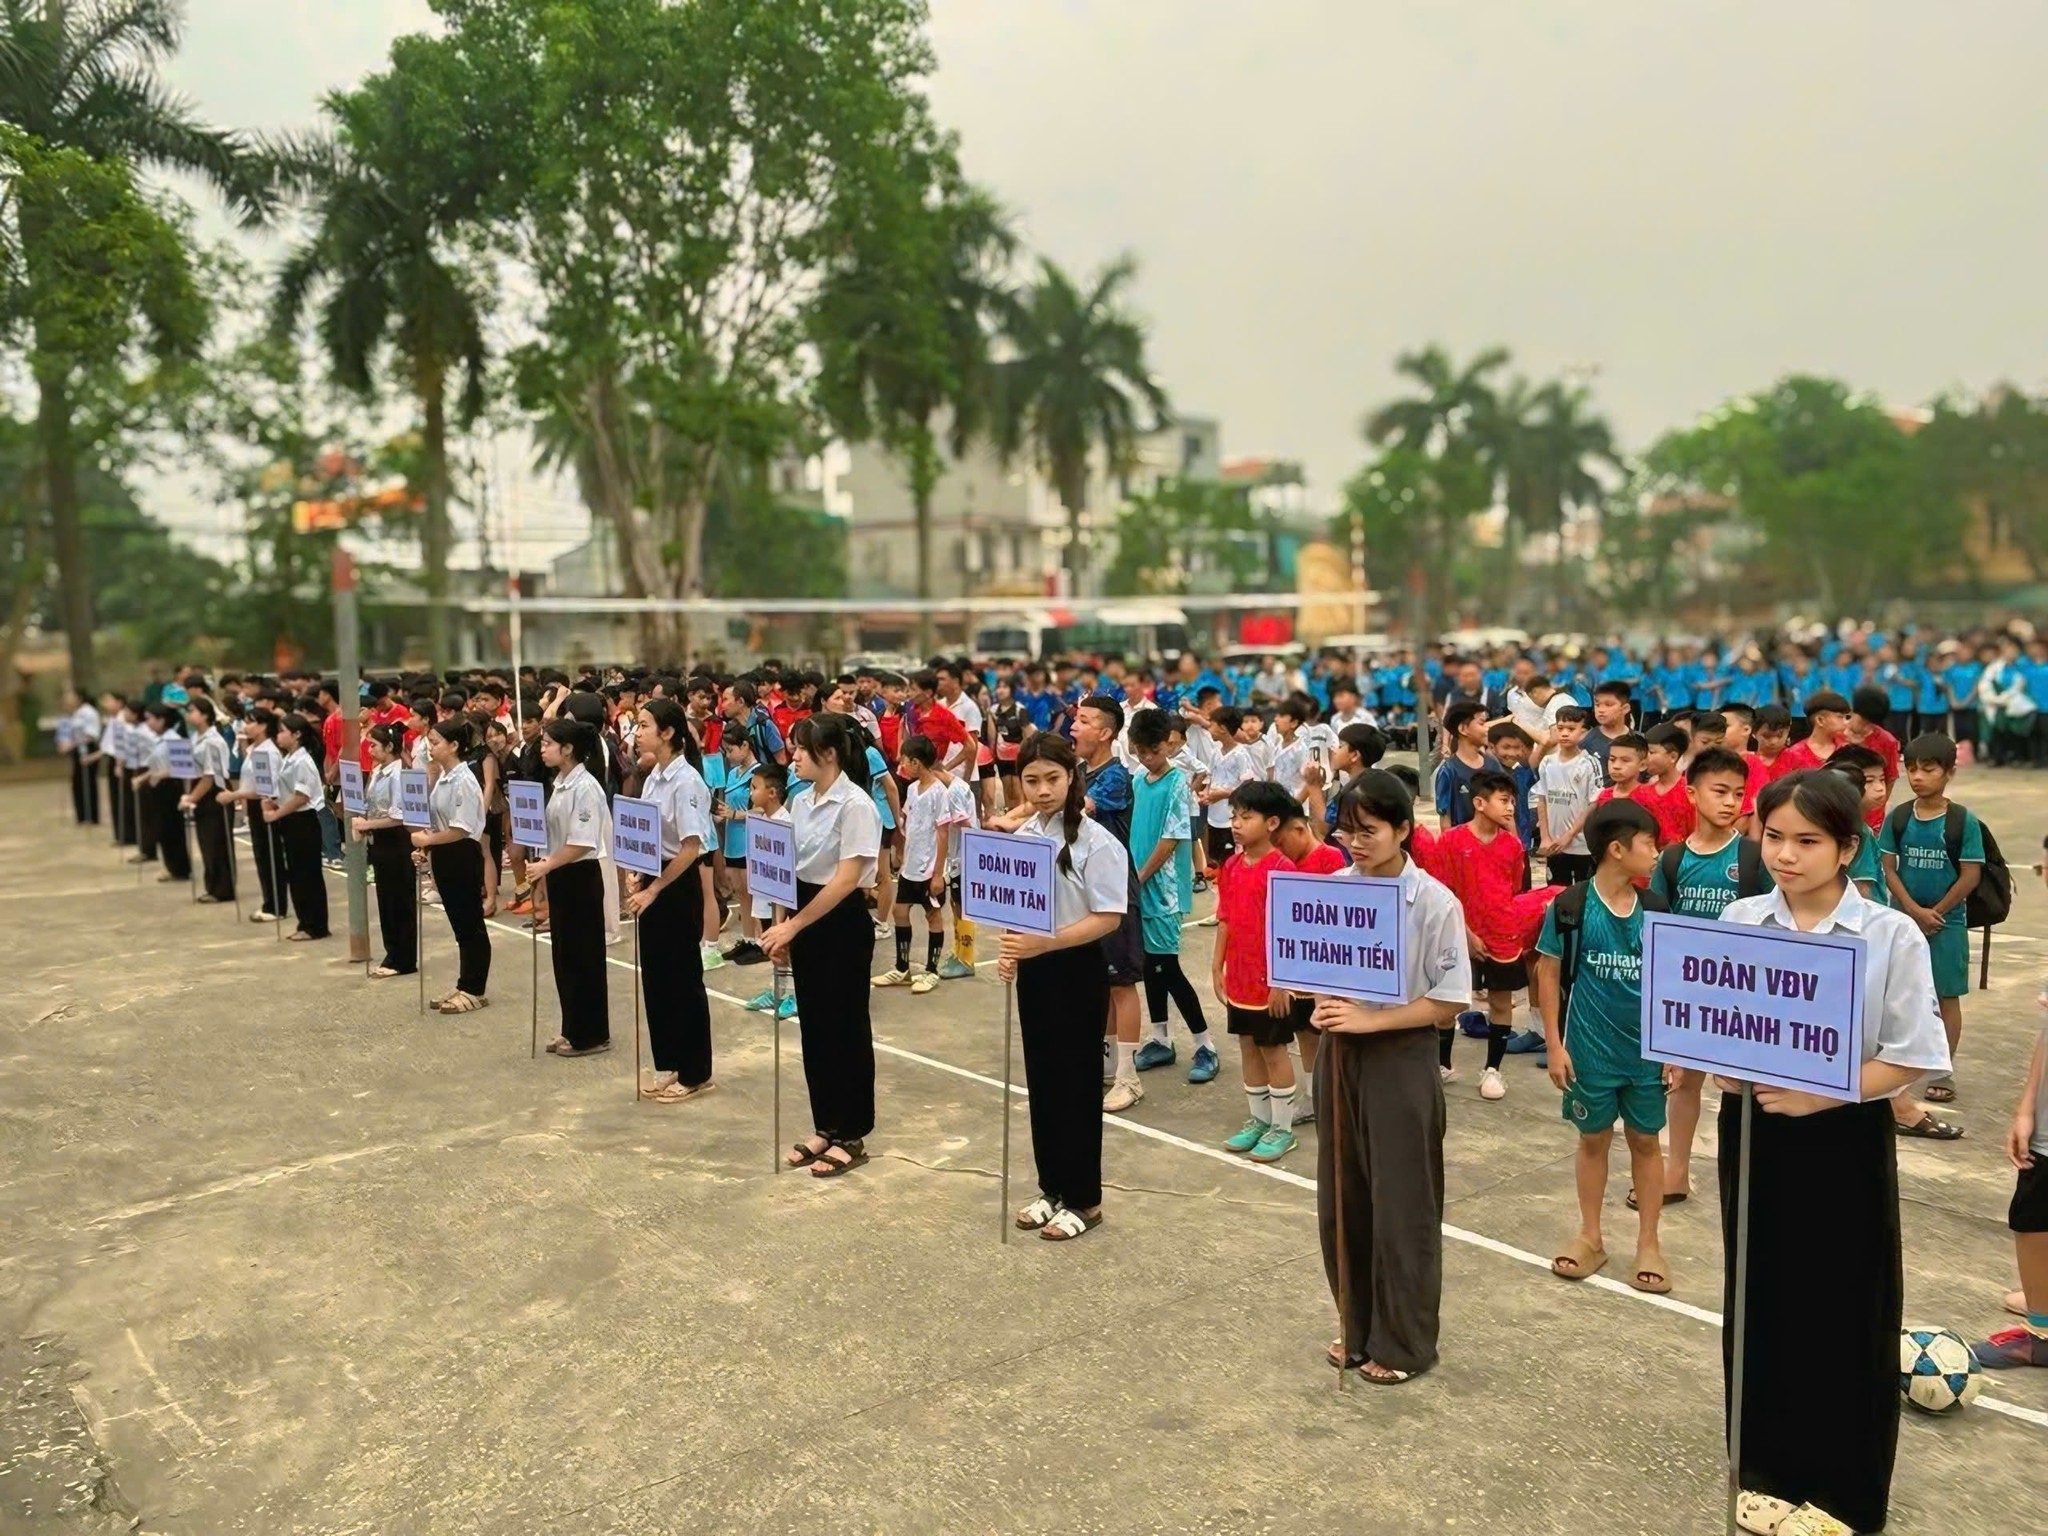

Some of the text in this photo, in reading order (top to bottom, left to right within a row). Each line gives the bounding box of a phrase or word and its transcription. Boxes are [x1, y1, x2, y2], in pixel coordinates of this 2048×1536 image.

[979, 852, 1036, 878] ĐOÀN VĐV
[971, 882, 1046, 911] TH KIM TÂN
[1292, 899, 1377, 929] ĐOÀN VĐV
[1277, 937, 1395, 971] TH THÀNH TIẾN
[1587, 949, 1642, 968] Emirate
[1682, 955, 1819, 1001] ĐOÀN VĐV
[1662, 1000, 1839, 1062] TH THÀNH THỌ
